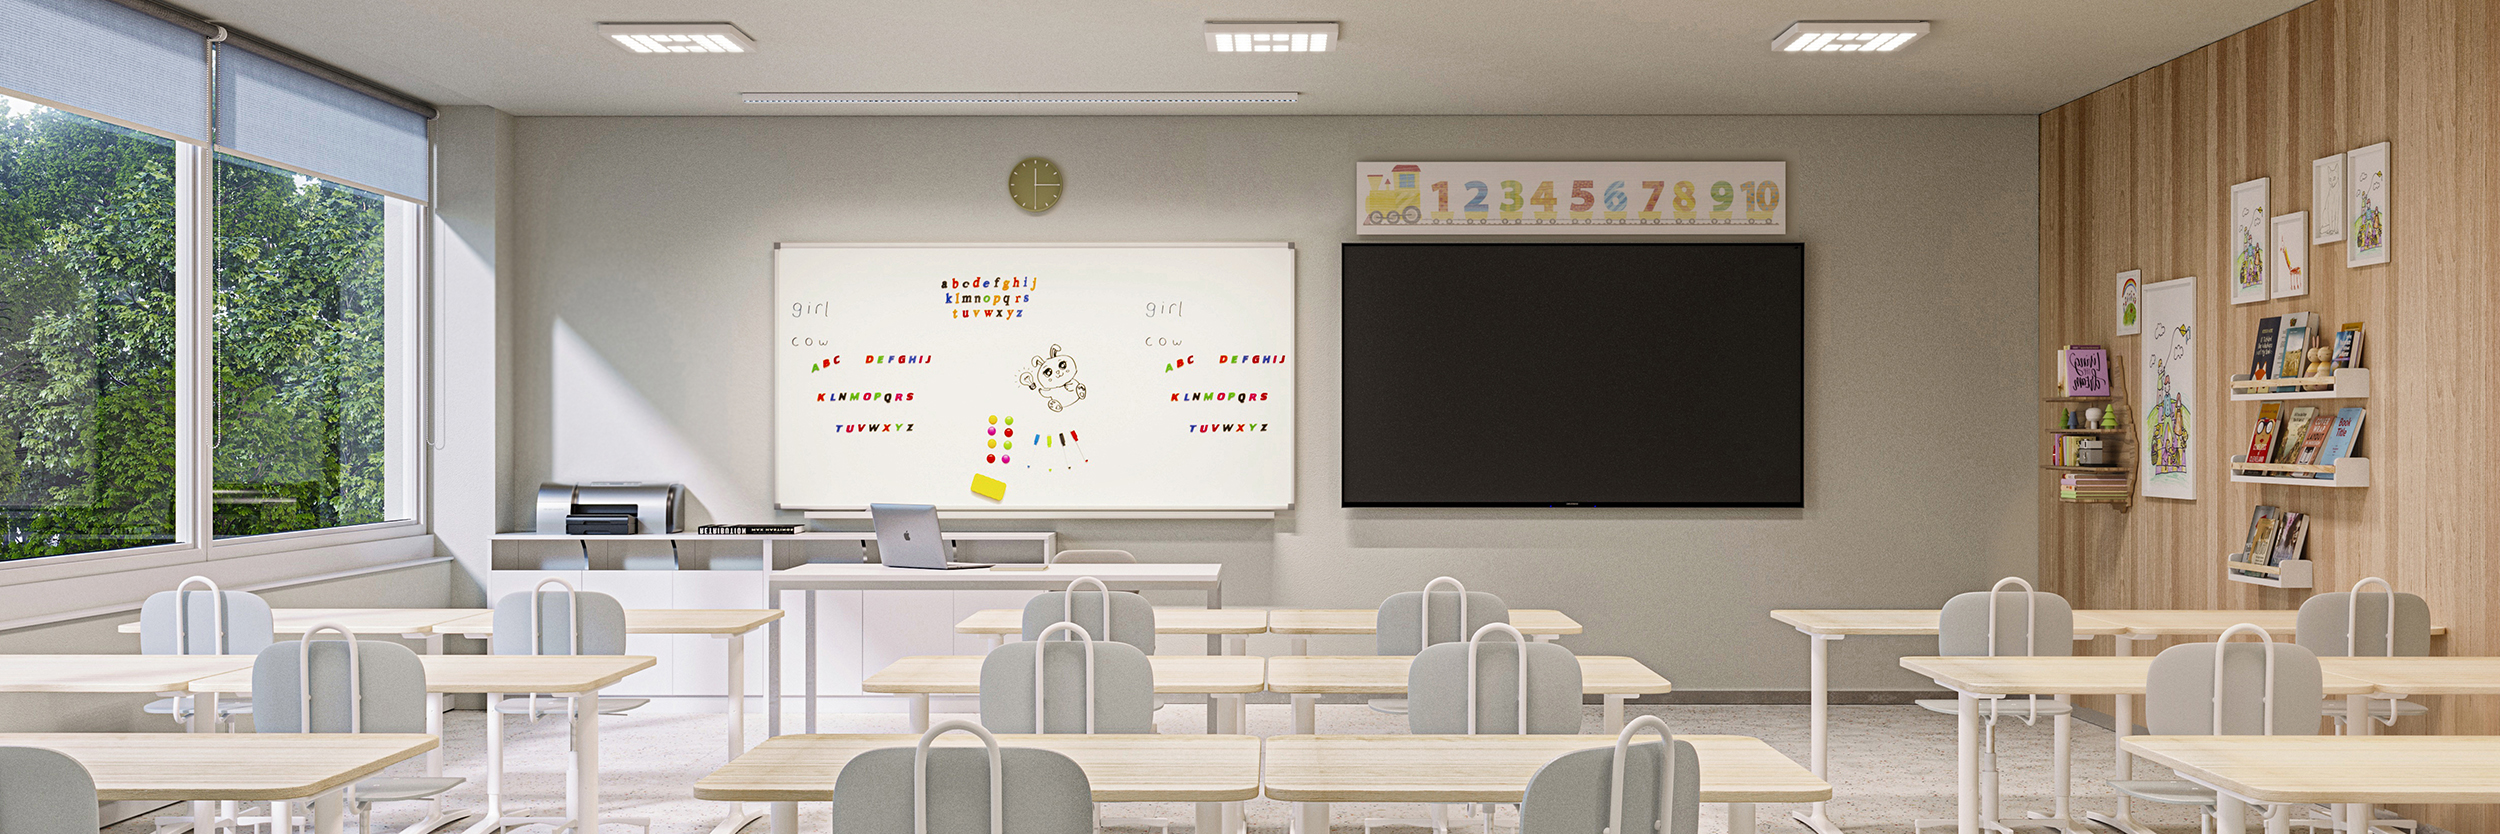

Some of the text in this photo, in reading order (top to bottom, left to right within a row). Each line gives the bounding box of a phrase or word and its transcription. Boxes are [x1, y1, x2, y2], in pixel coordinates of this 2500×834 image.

[1430, 180, 1780, 212] 1 2 3 4 5 6 7 8 9 10
[791, 301, 830, 318] girl
[1145, 301, 1183, 318] girl
[2338, 417, 2352, 427] Book
[2336, 427, 2348, 437] Title
